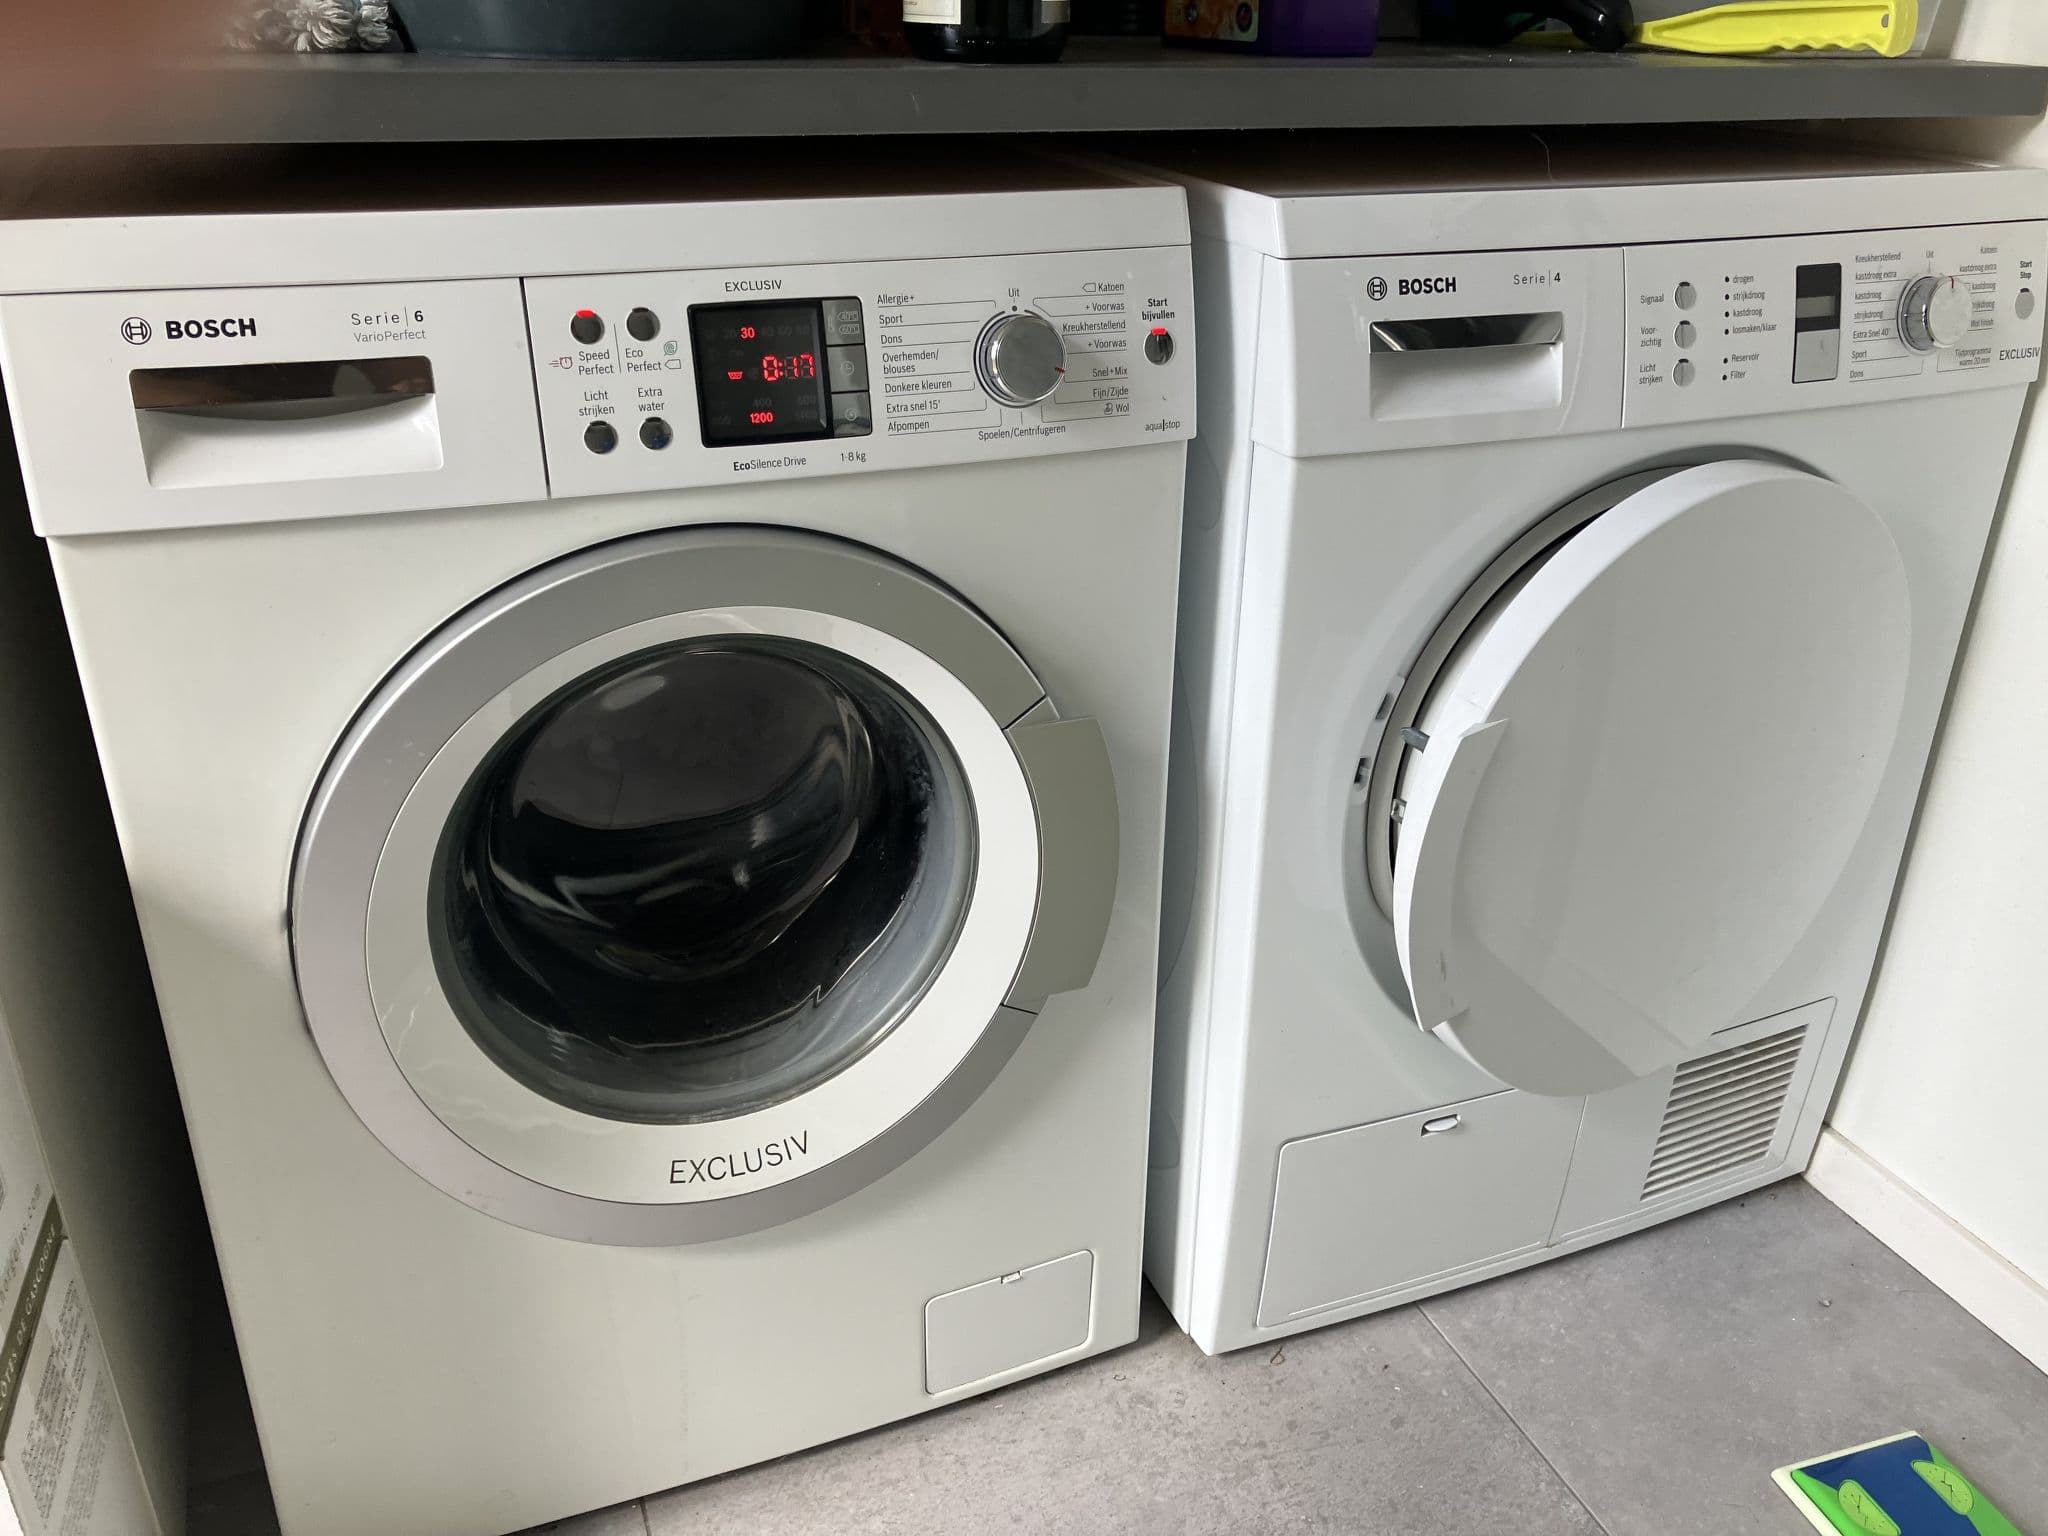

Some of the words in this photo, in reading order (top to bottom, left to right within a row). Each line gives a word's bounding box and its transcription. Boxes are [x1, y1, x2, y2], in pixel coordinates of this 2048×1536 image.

[1513, 273, 1545, 285] Serie
[1733, 275, 1754, 284] drogen
[725, 279, 782, 292] EXCLUSIV
[1098, 282, 1125, 292] Katoen
[1398, 276, 1456, 296] BOSCH
[1008, 288, 1020, 297] Uit
[1733, 291, 1765, 302] strijkdroog
[1147, 298, 1168, 308] Start
[1640, 293, 1664, 305] Signaal
[1092, 302, 1125, 312] Voorwas
[1733, 308, 1763, 318] kastdroog
[351, 311, 401, 327] Serie
[414, 310, 424, 323] 6
[879, 314, 903, 326] Sport
[1141, 309, 1175, 321] bijvullen
[165, 317, 257, 340] BOSCH
[1062, 320, 1126, 333] Kreukherstellend
[353, 329, 426, 343] VarioPerfect
[740, 327, 755, 340] 30
[880, 334, 903, 344] Dons
[1093, 338, 1127, 349] Voorwas
[1640, 337, 1662, 347] zichtig
[578, 350, 610, 364] Speed
[625, 348, 643, 358] Eco
[882, 349, 939, 363] Overhemden/
[1731, 352, 1760, 362] Reservoir
[1851, 350, 1867, 359] Sport
[2000, 347, 2040, 360] EXCLUSIV
[578, 362, 614, 375] Perfect
[627, 359, 662, 372] Perfect
[762, 354, 816, 381] 0:17
[883, 363, 916, 374] blouses
[1639, 363, 1656, 373] Licht
[1639, 375, 1663, 386] strijken
[1731, 370, 1746, 379] Filter
[884, 382, 919, 393] Donkere
[921, 379, 952, 390] kleuren
[584, 390, 609, 402] Licht
[638, 387, 663, 398] Extra
[1092, 386, 1129, 399] Fijn/Zijde
[578, 404, 615, 418] strijken
[638, 401, 665, 412] water
[886, 403, 908, 413] Extra
[910, 402, 927, 411] snel
[1115, 403, 1130, 413] Wol
[750, 412, 773, 424] 1200
[888, 420, 930, 433] Afpompen
[978, 424, 1066, 441] Spoelen/Centrifugeren
[853, 451, 866, 463] kg
[733, 459, 782, 471] EcoSilence
[784, 456, 807, 467] Drive
[669, 1130, 808, 1184] EXCLUSIV
